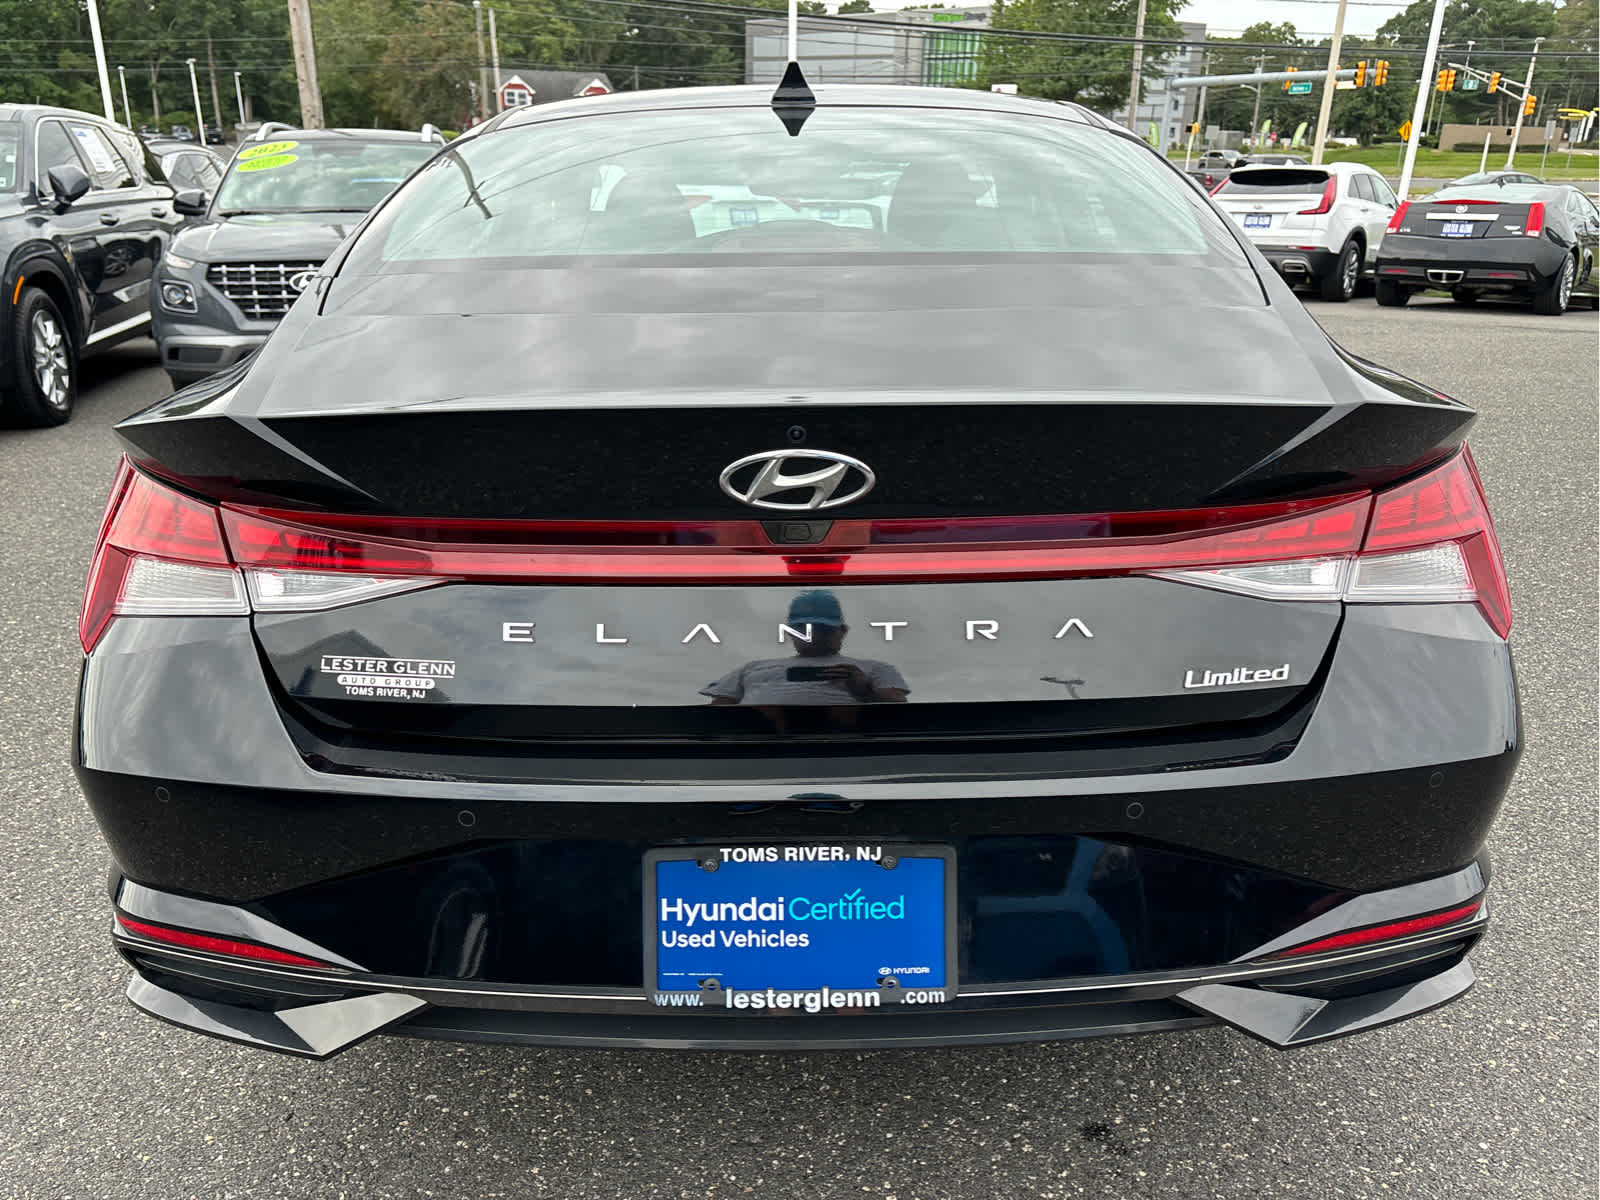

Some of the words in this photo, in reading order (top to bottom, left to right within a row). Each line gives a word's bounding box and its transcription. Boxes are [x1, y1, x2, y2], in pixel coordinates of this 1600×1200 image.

[502, 618, 1094, 643] ELANTRA
[320, 658, 387, 672] LESTER
[393, 661, 456, 675] GLENN
[1184, 663, 1290, 688] Limited
[341, 676, 376, 685] AUTO
[384, 678, 431, 687] GROUP
[345, 686, 374, 696] TOMS
[376, 688, 411, 699] RIVER,
[412, 690, 426, 698] NJ
[720, 848, 778, 862] TOMS
[785, 847, 850, 862] RIVER,
[857, 846, 882, 861] NJ
[661, 897, 785, 926] Hyundai
[788, 888, 905, 920] Certified
[661, 930, 716, 947] Used
[720, 929, 810, 947] Vehicles
[654, 993, 704, 1006] www.
[726, 987, 880, 1013] lesterglenn
[900, 990, 945, 1004] .com
